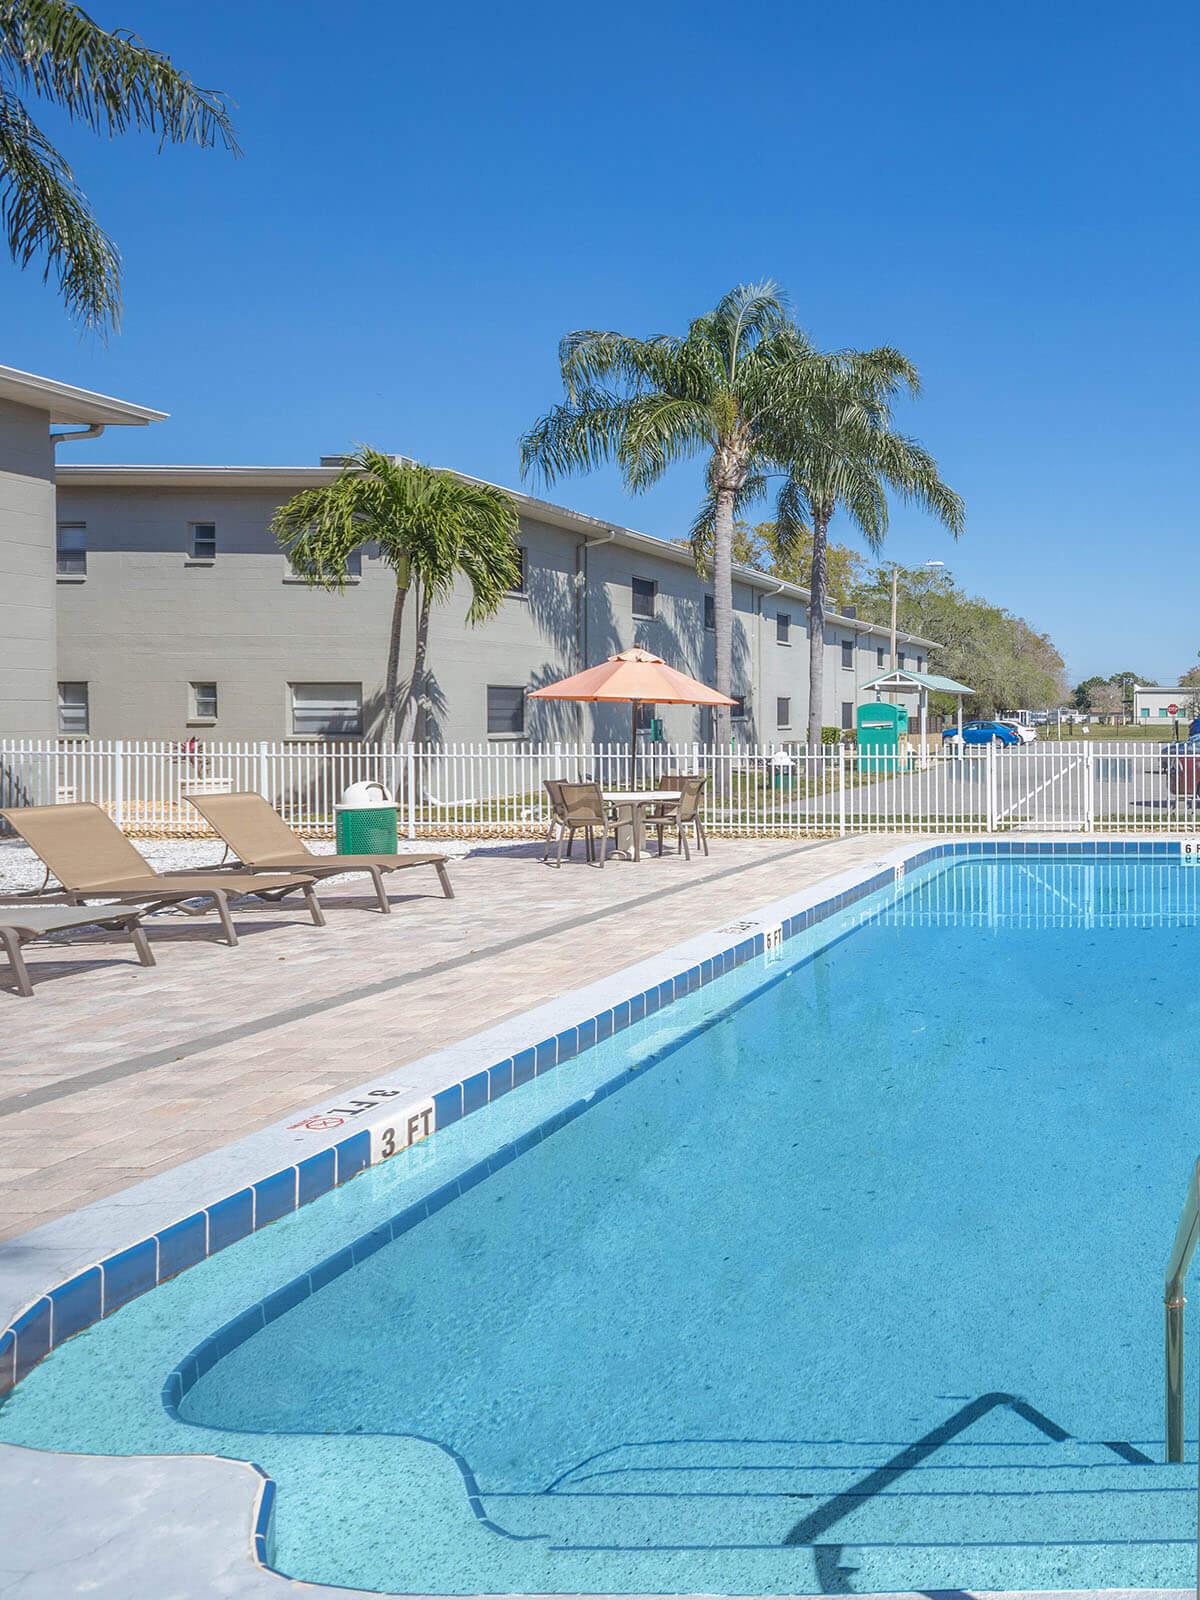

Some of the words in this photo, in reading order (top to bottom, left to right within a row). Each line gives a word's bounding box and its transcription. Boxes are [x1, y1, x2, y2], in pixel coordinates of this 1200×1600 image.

[1185, 844, 1192, 854] 6
[774, 928, 782, 946] FT
[368, 1089, 400, 1097] 3
[326, 1100, 379, 1115] FT
[382, 1127, 395, 1159] 3
[407, 1107, 433, 1146] FT
